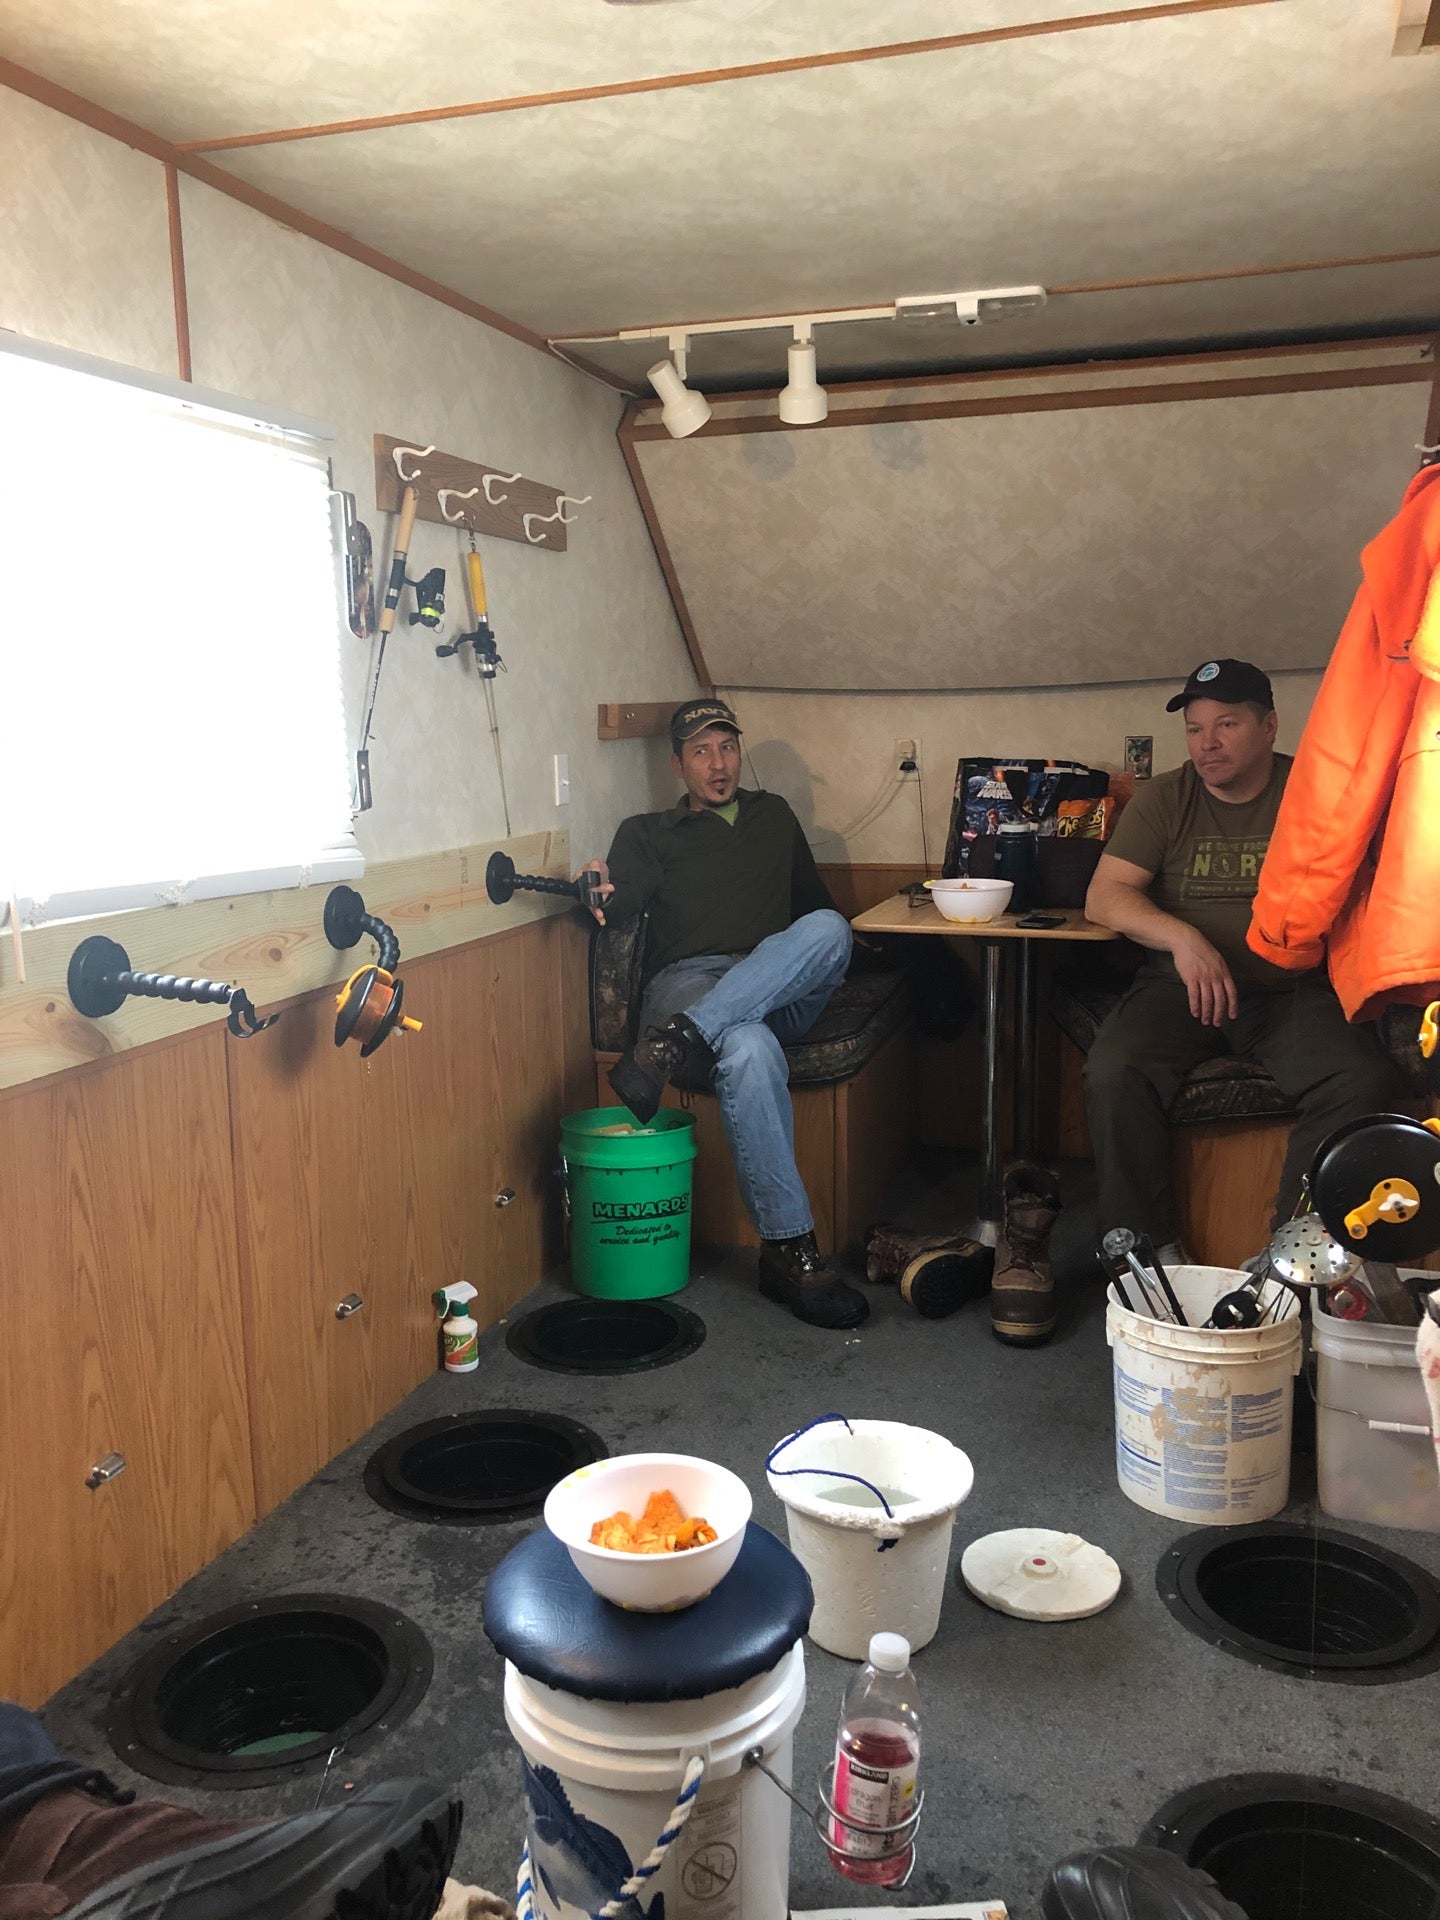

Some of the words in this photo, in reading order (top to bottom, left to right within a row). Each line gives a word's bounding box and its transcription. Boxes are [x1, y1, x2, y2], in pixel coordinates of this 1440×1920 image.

[983, 780, 1008, 790] STAR
[976, 788, 1013, 800] WARS
[593, 1193, 689, 1218] MENARDS
